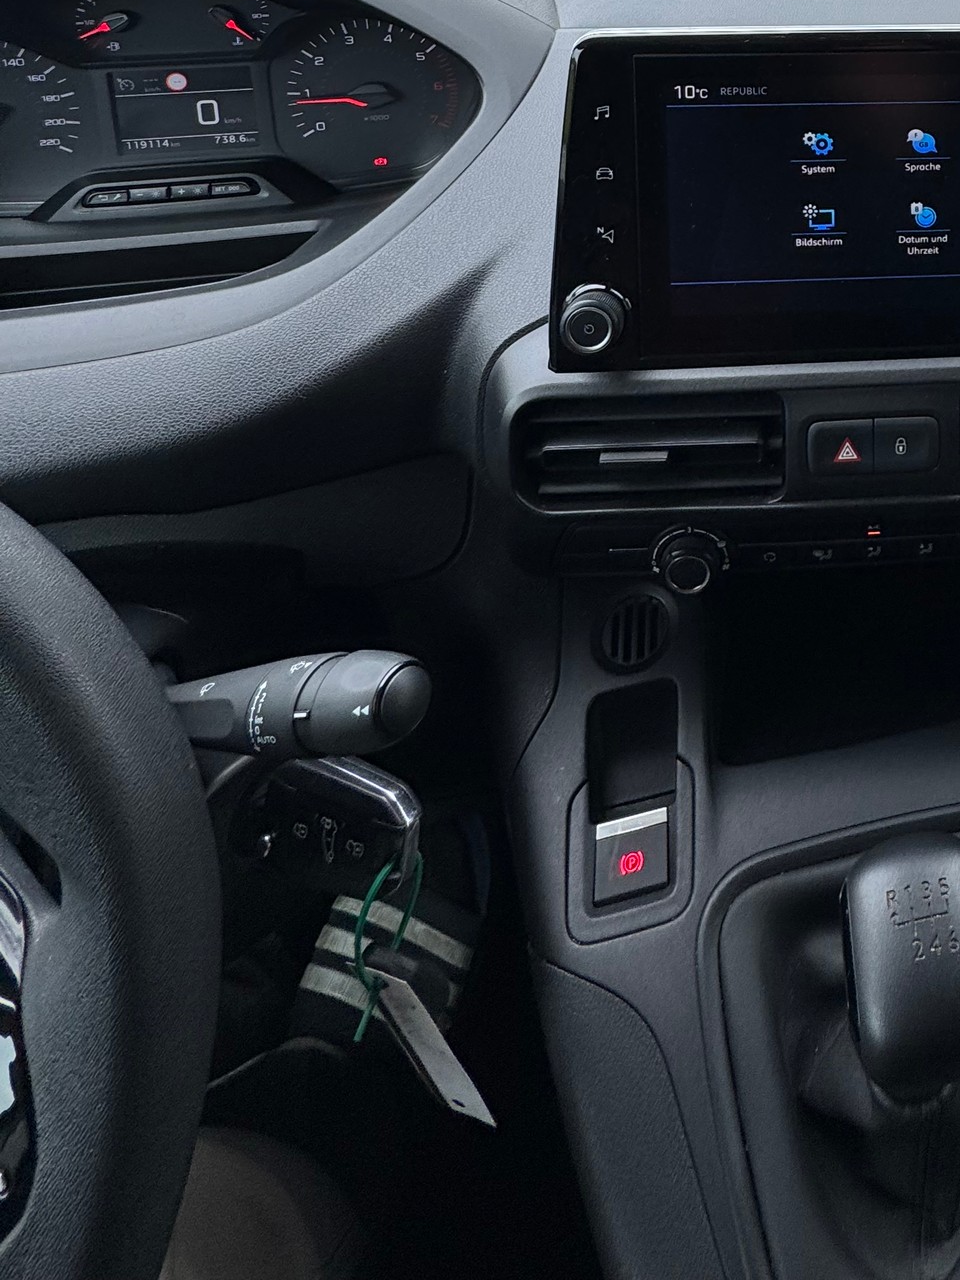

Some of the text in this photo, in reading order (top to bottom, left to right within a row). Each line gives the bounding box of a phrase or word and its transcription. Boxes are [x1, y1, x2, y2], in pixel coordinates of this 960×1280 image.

[344, 35, 354, 45] 3
[383, 34, 393, 44] 4
[314, 56, 324, 66] 2
[415, 52, 426, 61] 5
[2, 58, 25, 68] 140
[27, 74, 47, 82] 160
[304, 88, 311, 98] 1
[720, 86, 768, 96] REPUBLIC
[41, 95, 60, 103] 180
[196, 99, 220, 126] 0
[44, 118, 66, 127] 200
[315, 121, 326, 132] 0
[39, 138, 60, 147] 220
[126, 138, 170, 150] 119114
[214, 134, 246, 145] 738.6
[801, 164, 836, 175] System
[904, 162, 942, 173] Sprache
[596, 226, 605, 234] N
[795, 236, 843, 247] Bildschirm
[898, 234, 948, 244] Datum und
[907, 246, 940, 255] Uhrzeit
[256, 735, 277, 744] AUTO
[885, 889, 899, 911] R
[920, 880, 933, 900] 3
[911, 937, 926, 962] 2
[930, 933, 943, 956] 4
